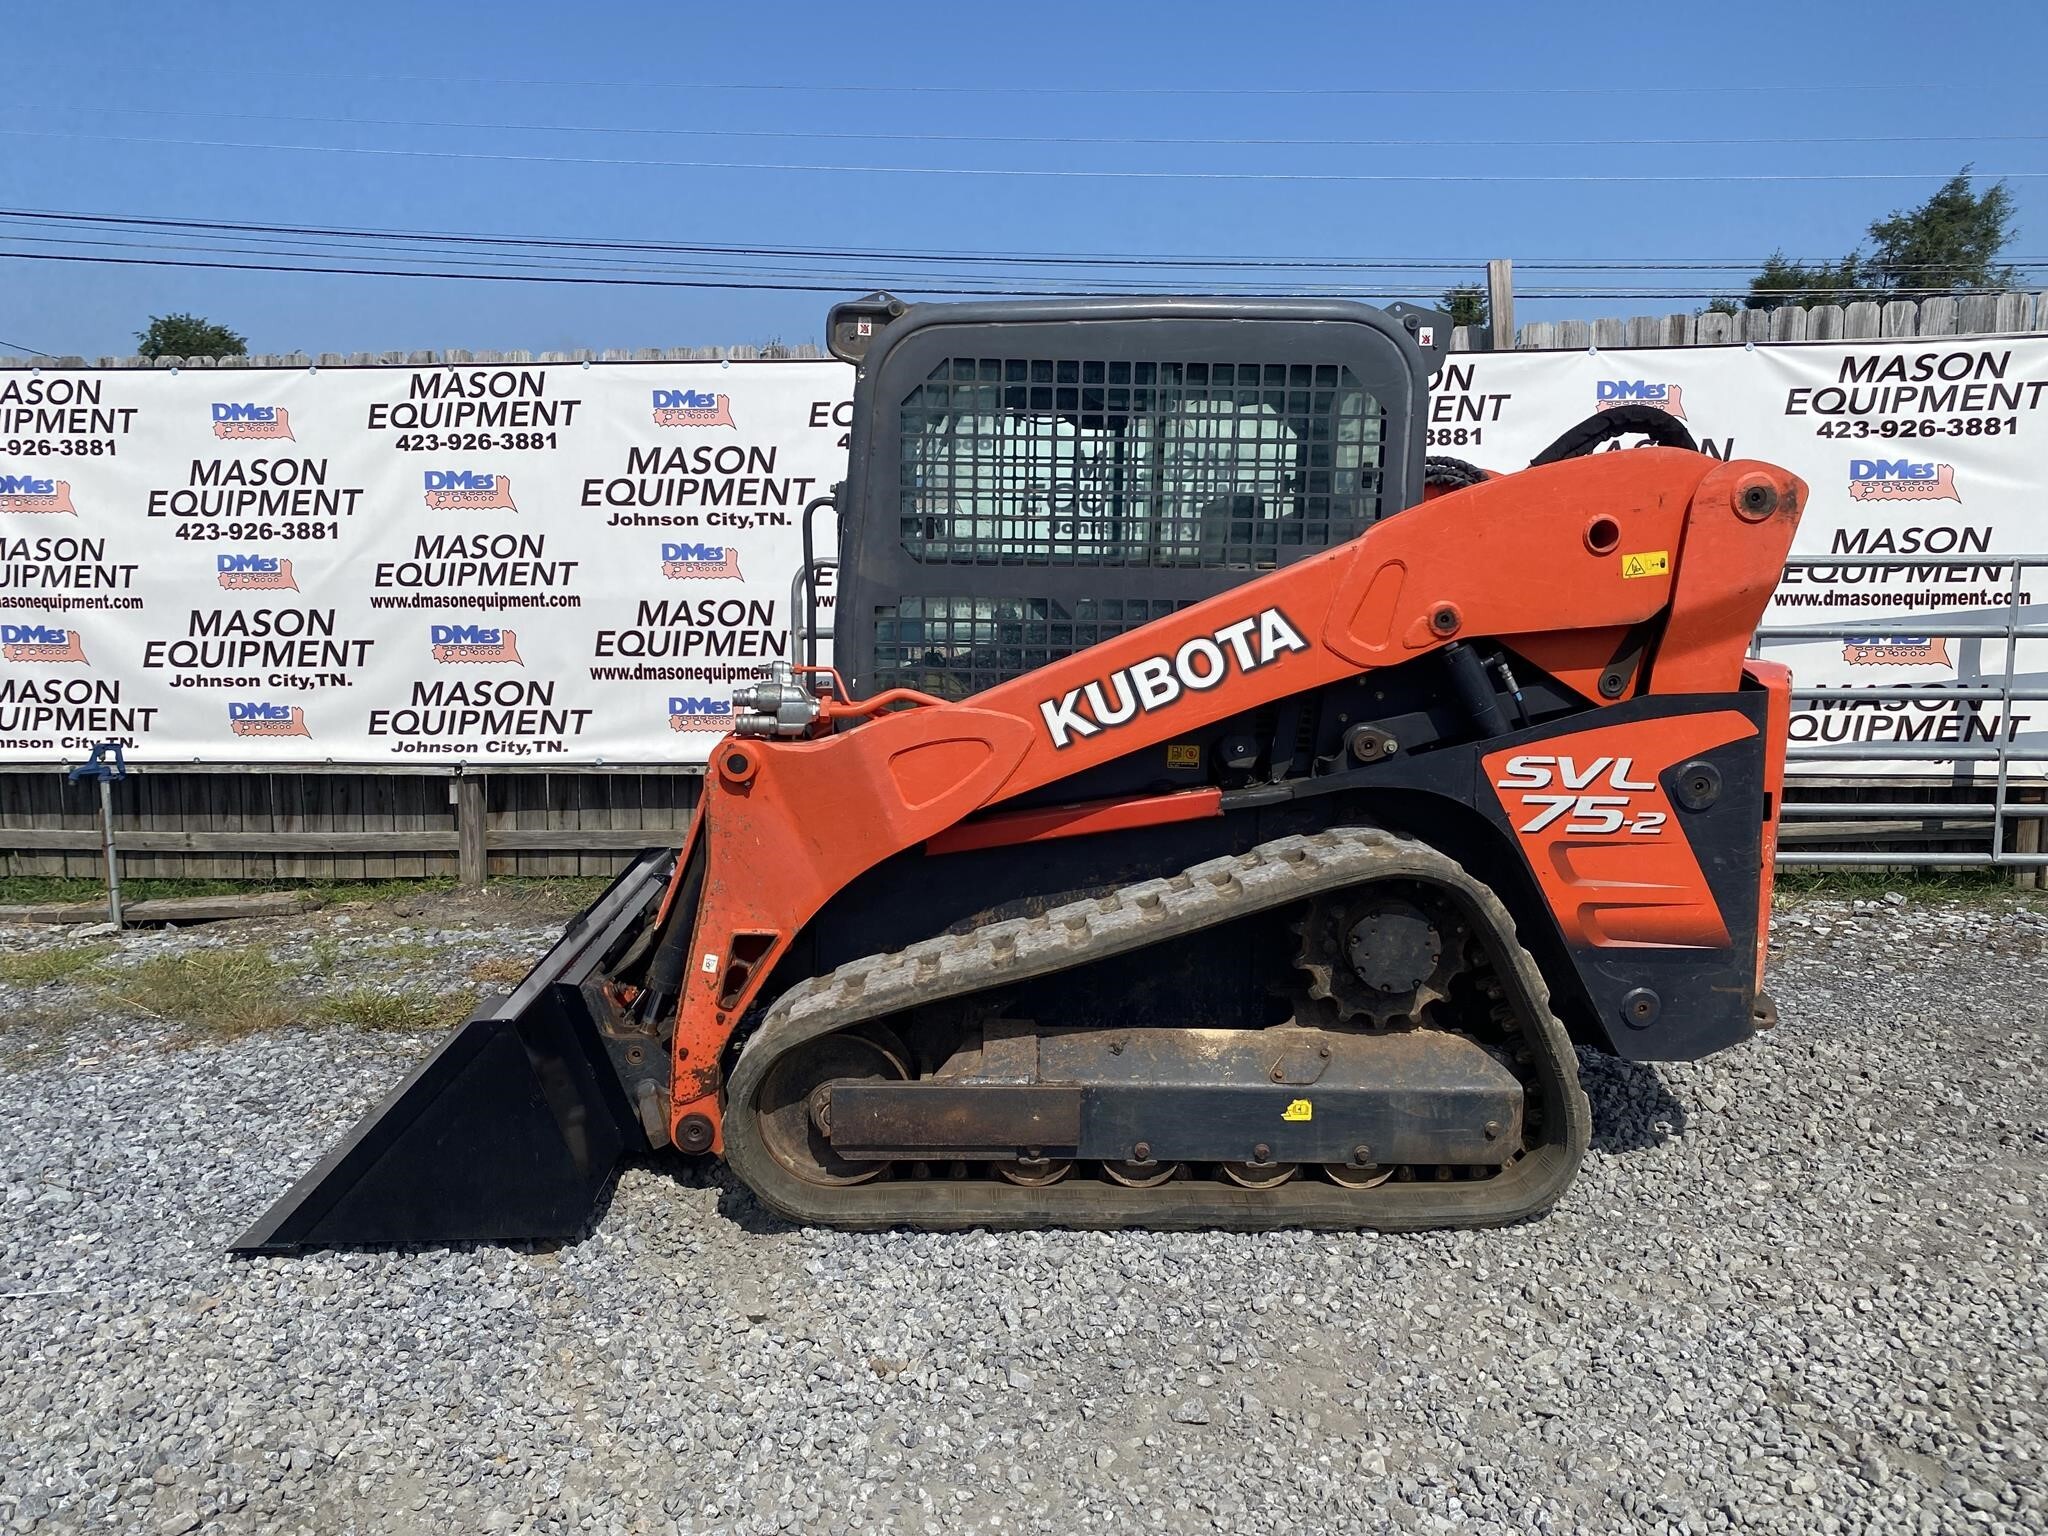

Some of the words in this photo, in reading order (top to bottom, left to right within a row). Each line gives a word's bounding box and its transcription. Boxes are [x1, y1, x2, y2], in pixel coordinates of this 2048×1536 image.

[1839, 351, 2011, 383] MASON
[410, 371, 545, 399] MASON
[1785, 381, 2048, 415] EQUIPMENT
[0, 409, 138, 433] IPMENT
[368, 400, 581, 429] EQUIPMENT
[1817, 416, 2017, 439] 423-926-3881
[396, 433, 556, 451] 423-926-3881
[190, 459, 327, 486] MASON
[627, 446, 776, 474] MASON
[148, 489, 363, 517] EQUIPMENT
[581, 478, 815, 506] EQUIPMENT
[176, 522, 337, 540] 423-926-3881
[607, 513, 698, 526] Johnson
[415, 535, 544, 559] MASON
[1832, 527, 1992, 554] MASON
[375, 562, 578, 586] EQUIPMENT
[1780, 567, 2014, 584] EQUIPMEN
[0, 594, 143, 612] asonequipment.com
[371, 592, 580, 611] www.dmasonequipment.com
[1774, 589, 2031, 609] www.dmasonequipment.com
[189, 609, 335, 637] MASON
[637, 600, 774, 626] MASON
[143, 640, 374, 668] EQUIPMENT
[595, 630, 792, 657] EQUIPMEN
[170, 675, 260, 687] Johnson
[1039, 608, 1305, 748] KUBOTA
[412, 681, 554, 706] MASON
[369, 710, 592, 735] EQUIPMENT
[391, 741, 483, 753] Johnson
[1497, 756, 1656, 790] SVL
[1518, 795, 1667, 834] 75-2
